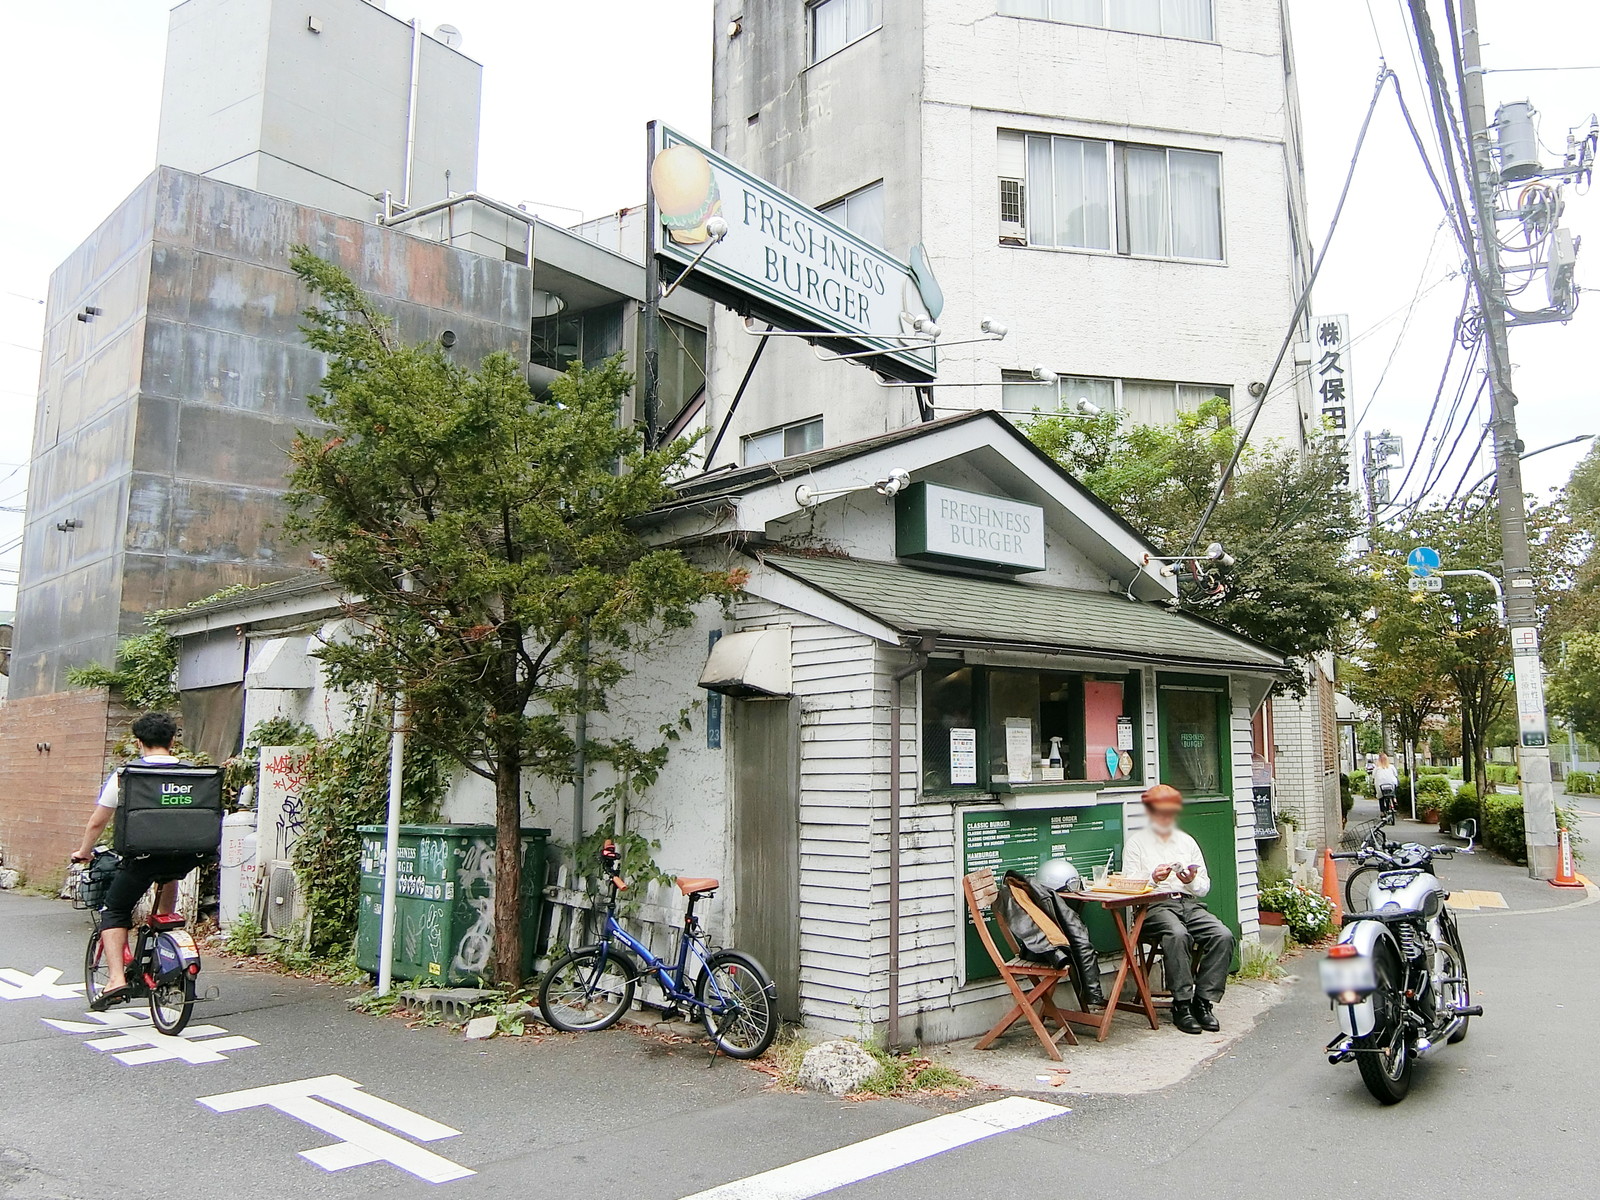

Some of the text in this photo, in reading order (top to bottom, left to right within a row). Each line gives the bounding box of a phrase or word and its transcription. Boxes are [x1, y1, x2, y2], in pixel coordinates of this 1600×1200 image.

[742, 189, 885, 296] FRESHNESS
[764, 246, 871, 329] BURGER
[940, 498, 1031, 534] FRESHNESS
[950, 523, 1024, 554] BURGER
[708, 729, 720, 741] 23
[1180, 733, 1205, 741] FRESHNESS
[1183, 740, 1203, 748] BURGER
[161, 783, 193, 794] Uber
[161, 794, 193, 805] Eats
[967, 820, 1011, 830] CLASSIC BURGER
[397, 861, 414, 873] RGER
